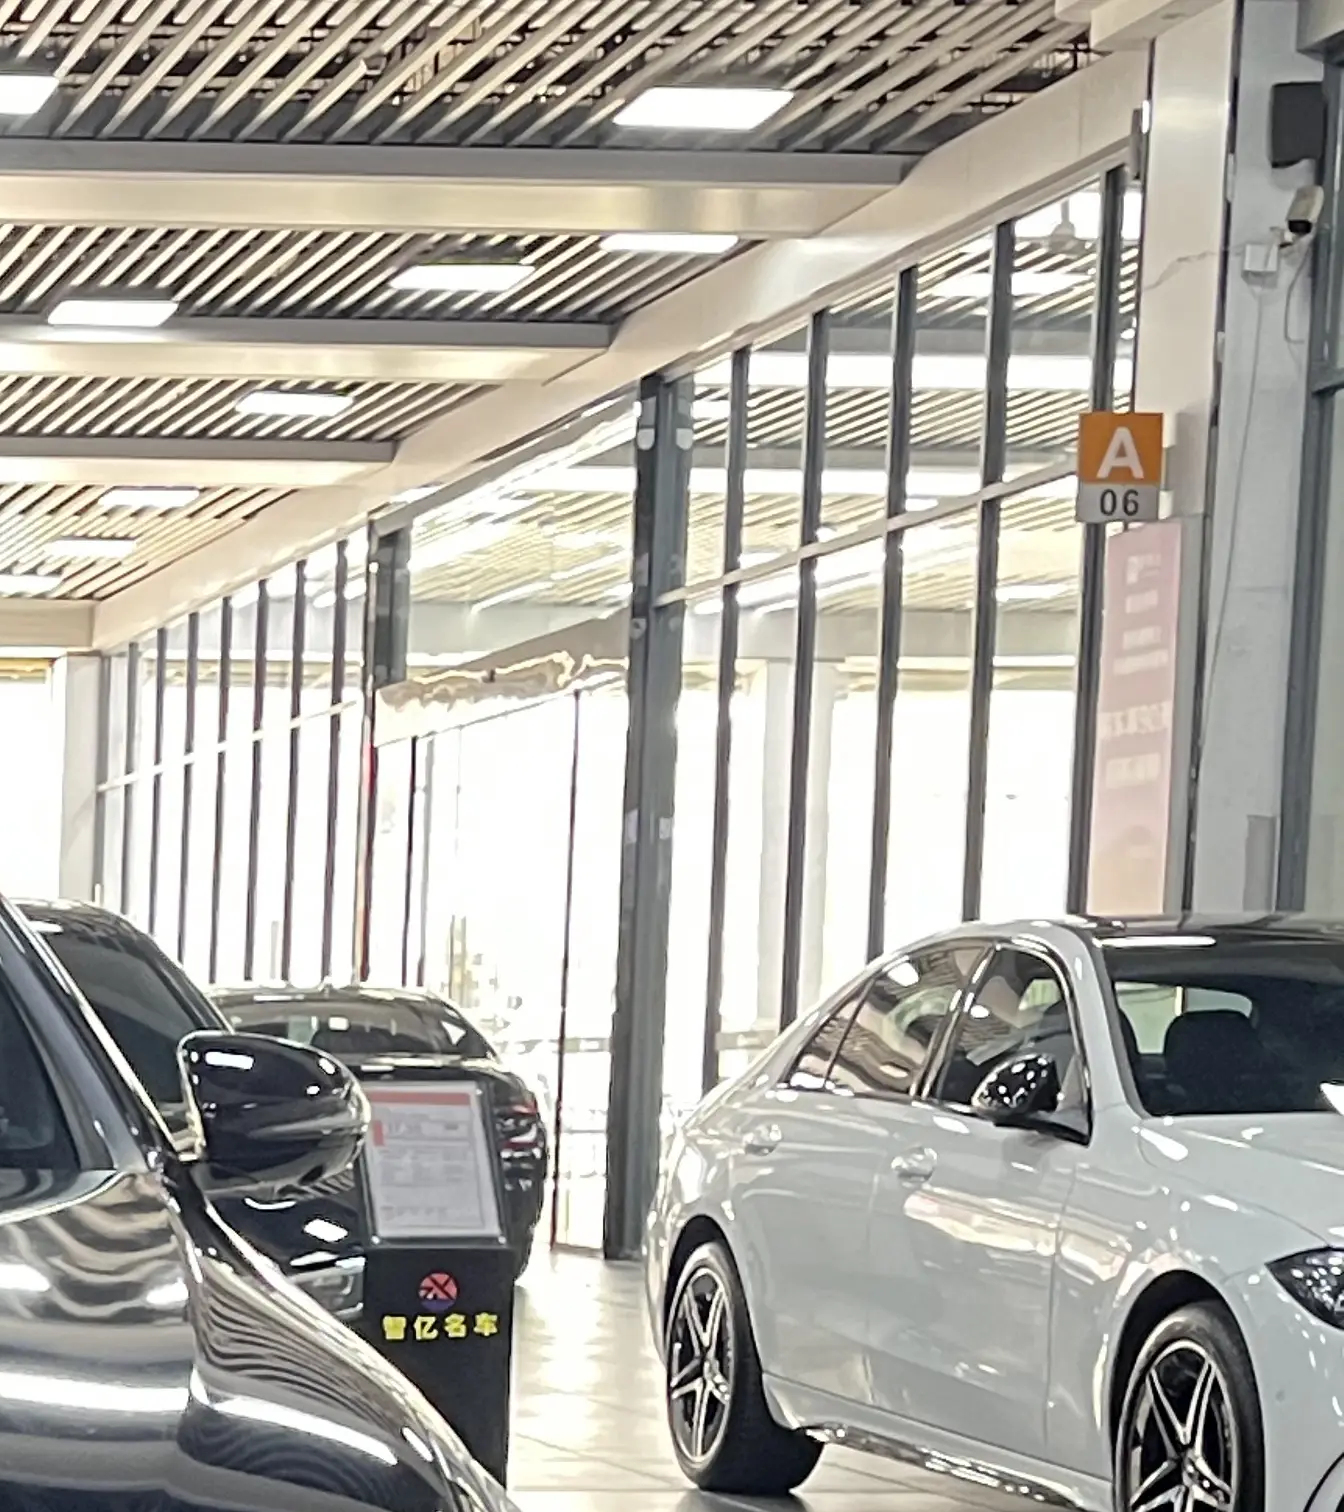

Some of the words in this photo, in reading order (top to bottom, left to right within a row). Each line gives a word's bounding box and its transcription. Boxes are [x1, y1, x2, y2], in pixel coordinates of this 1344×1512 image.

[1097, 427, 1143, 478] A
[1100, 488, 1139, 516] 06
[382, 1313, 498, 1340] 智亿名车
